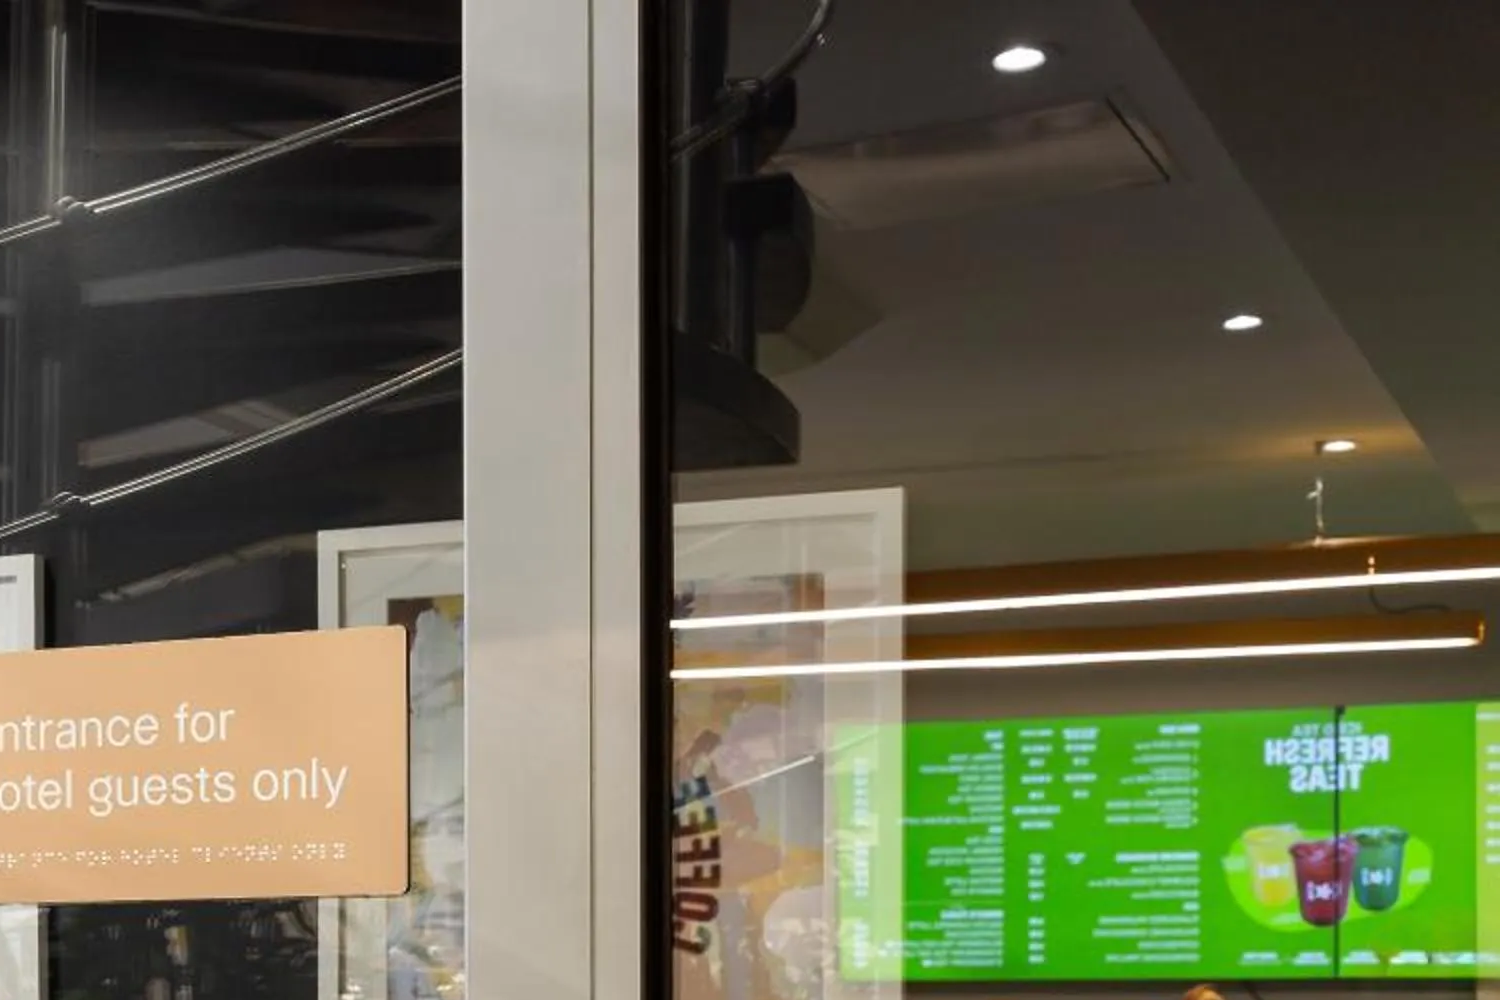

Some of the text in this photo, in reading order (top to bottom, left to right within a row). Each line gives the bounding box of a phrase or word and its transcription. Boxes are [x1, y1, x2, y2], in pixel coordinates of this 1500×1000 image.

[173, 702, 236, 743] for
[88, 766, 236, 817] guests
[252, 756, 348, 809] only
